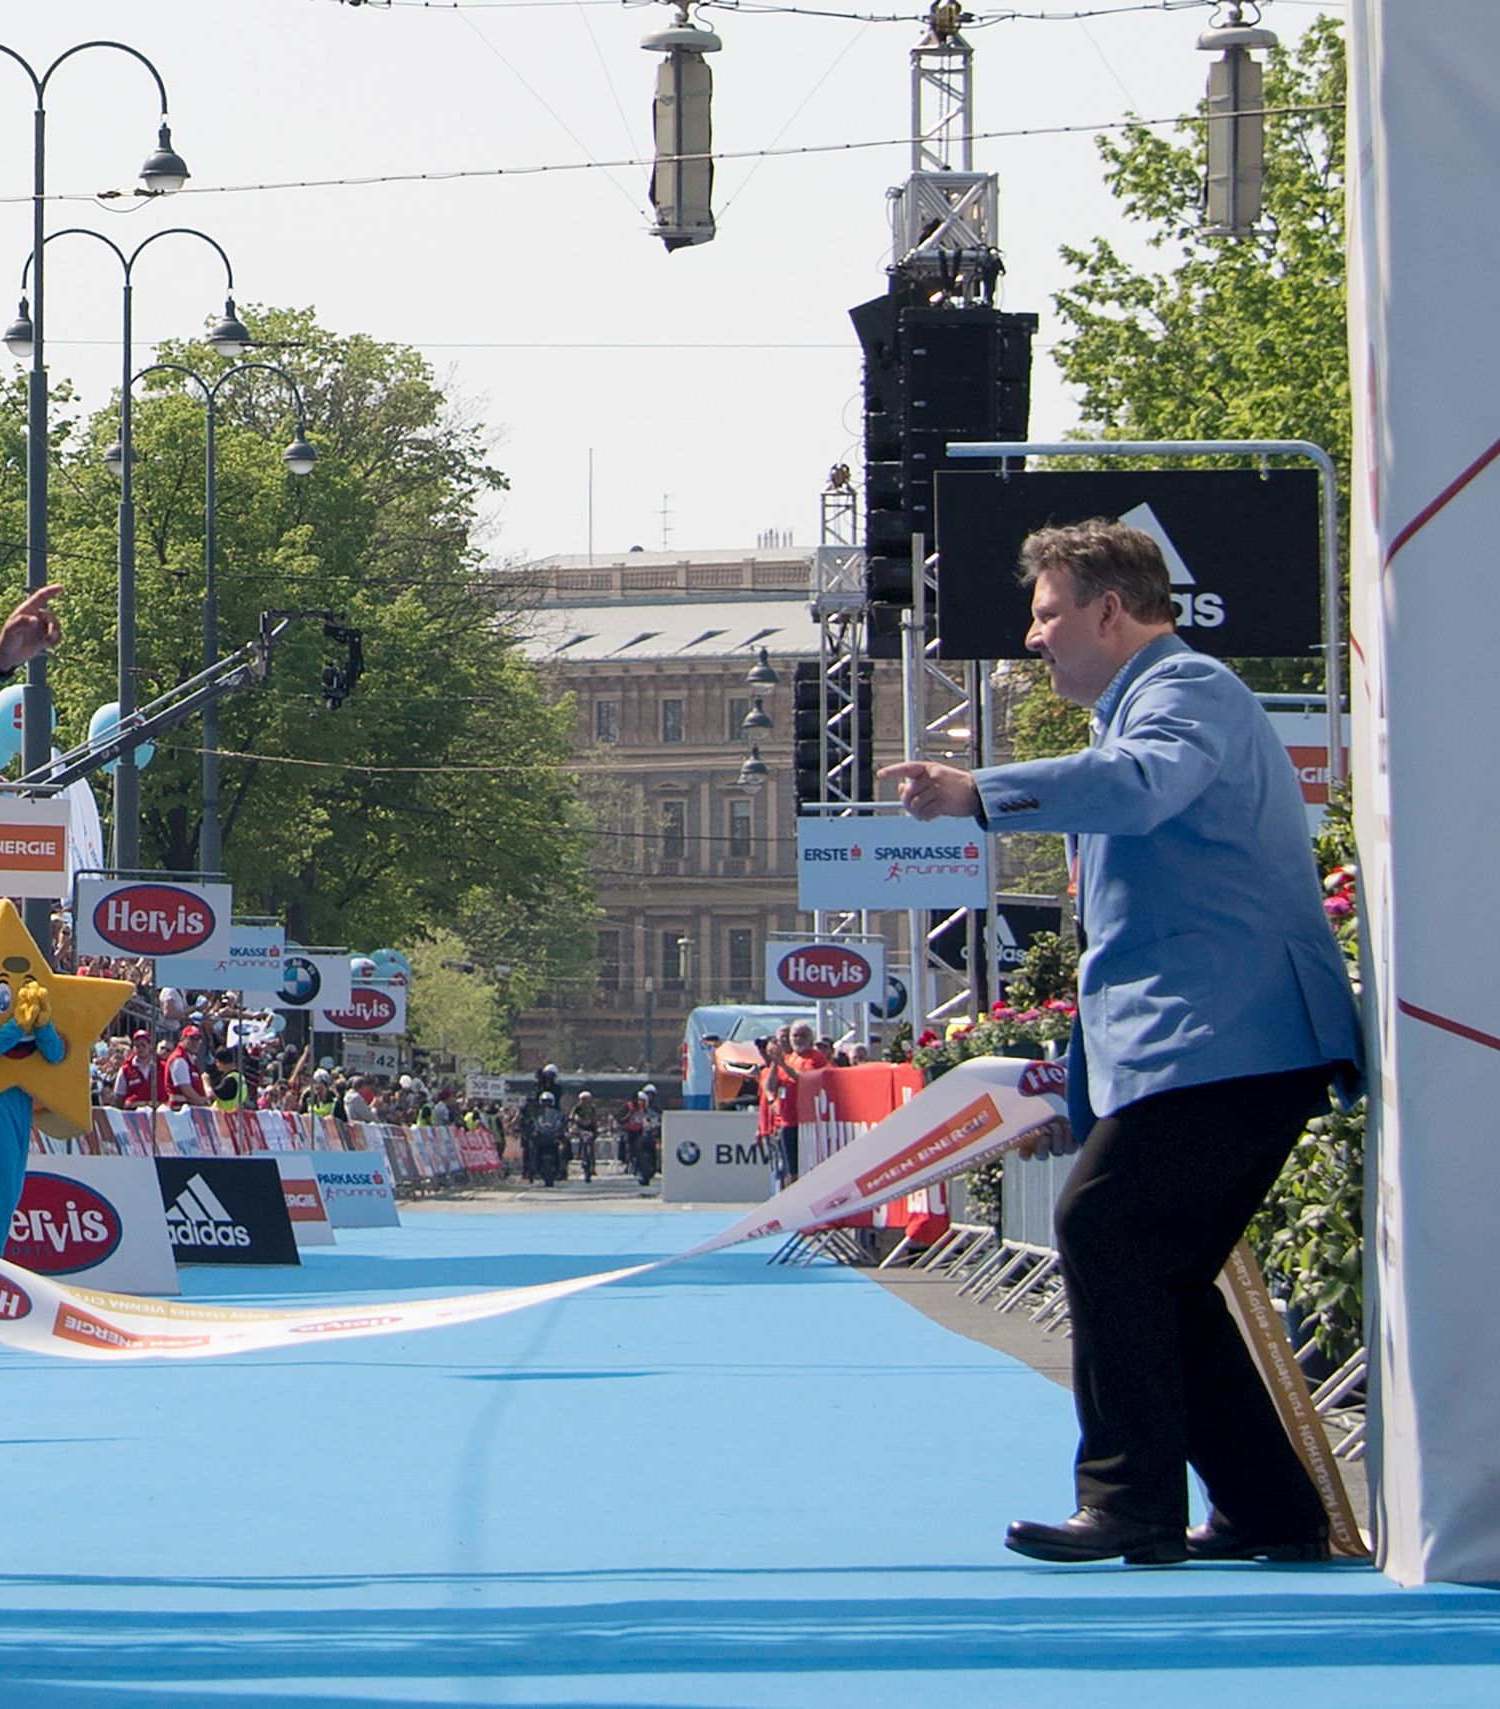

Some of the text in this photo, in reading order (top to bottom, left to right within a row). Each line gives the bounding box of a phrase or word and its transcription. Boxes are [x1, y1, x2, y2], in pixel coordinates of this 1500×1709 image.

[804, 848, 849, 862] ERSTE
[875, 846, 962, 861] SPARKASSE
[903, 862, 979, 877] running
[107, 900, 205, 942] Hervis
[788, 957, 864, 989] Hervis
[867, 1158, 915, 1191] WIEN
[919, 1109, 990, 1161] ENERGIE
[336, 1186, 388, 1199] running
[8, 1199, 110, 1254] ervis
[108, 1297, 166, 1315] VIENNA
[1297, 1422, 1338, 1508] MARATHON
